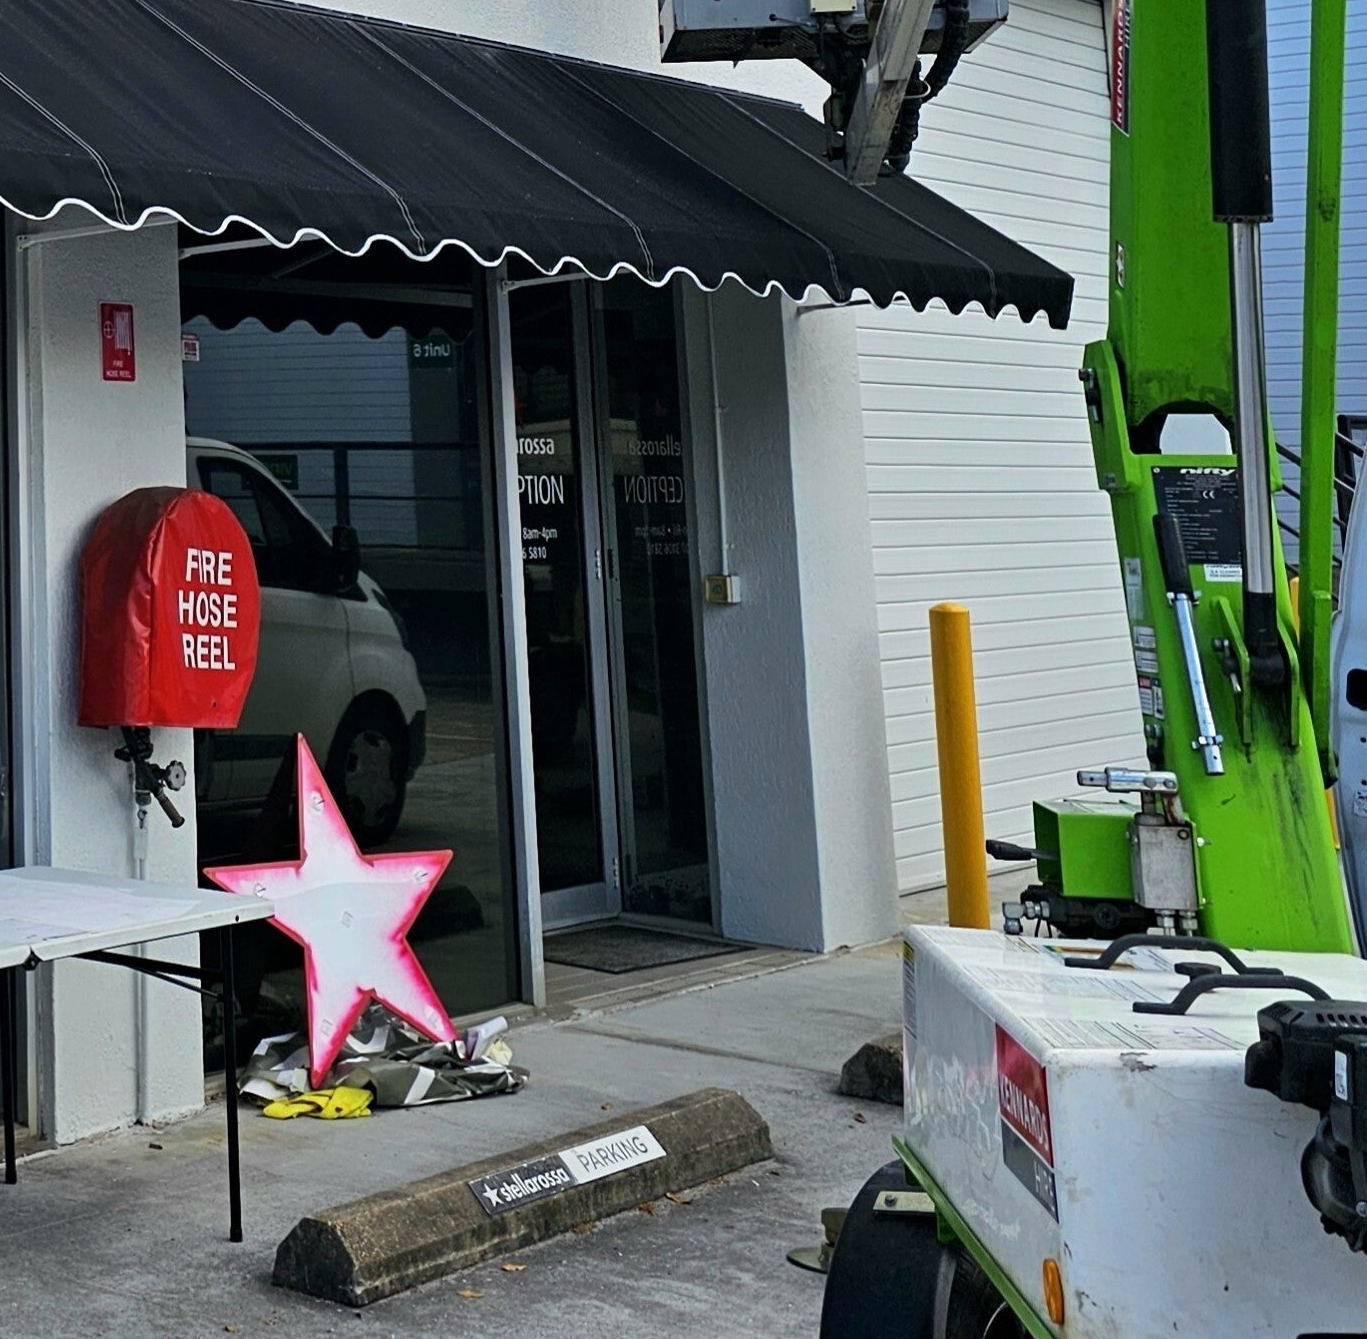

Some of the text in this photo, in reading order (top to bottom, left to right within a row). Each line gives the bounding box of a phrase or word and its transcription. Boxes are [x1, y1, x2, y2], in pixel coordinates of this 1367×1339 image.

[516, 437, 555, 455] rossa
[522, 527, 558, 541] 8am-4pm
[528, 546, 547, 559] 5810
[185, 548, 233, 586] FIRE
[178, 590, 238, 629] HOSE
[182, 633, 236, 671] REEL
[999, 1072, 1050, 1152] KENNARDS
[500, 1136, 649, 1202] stellarossa PARKING
